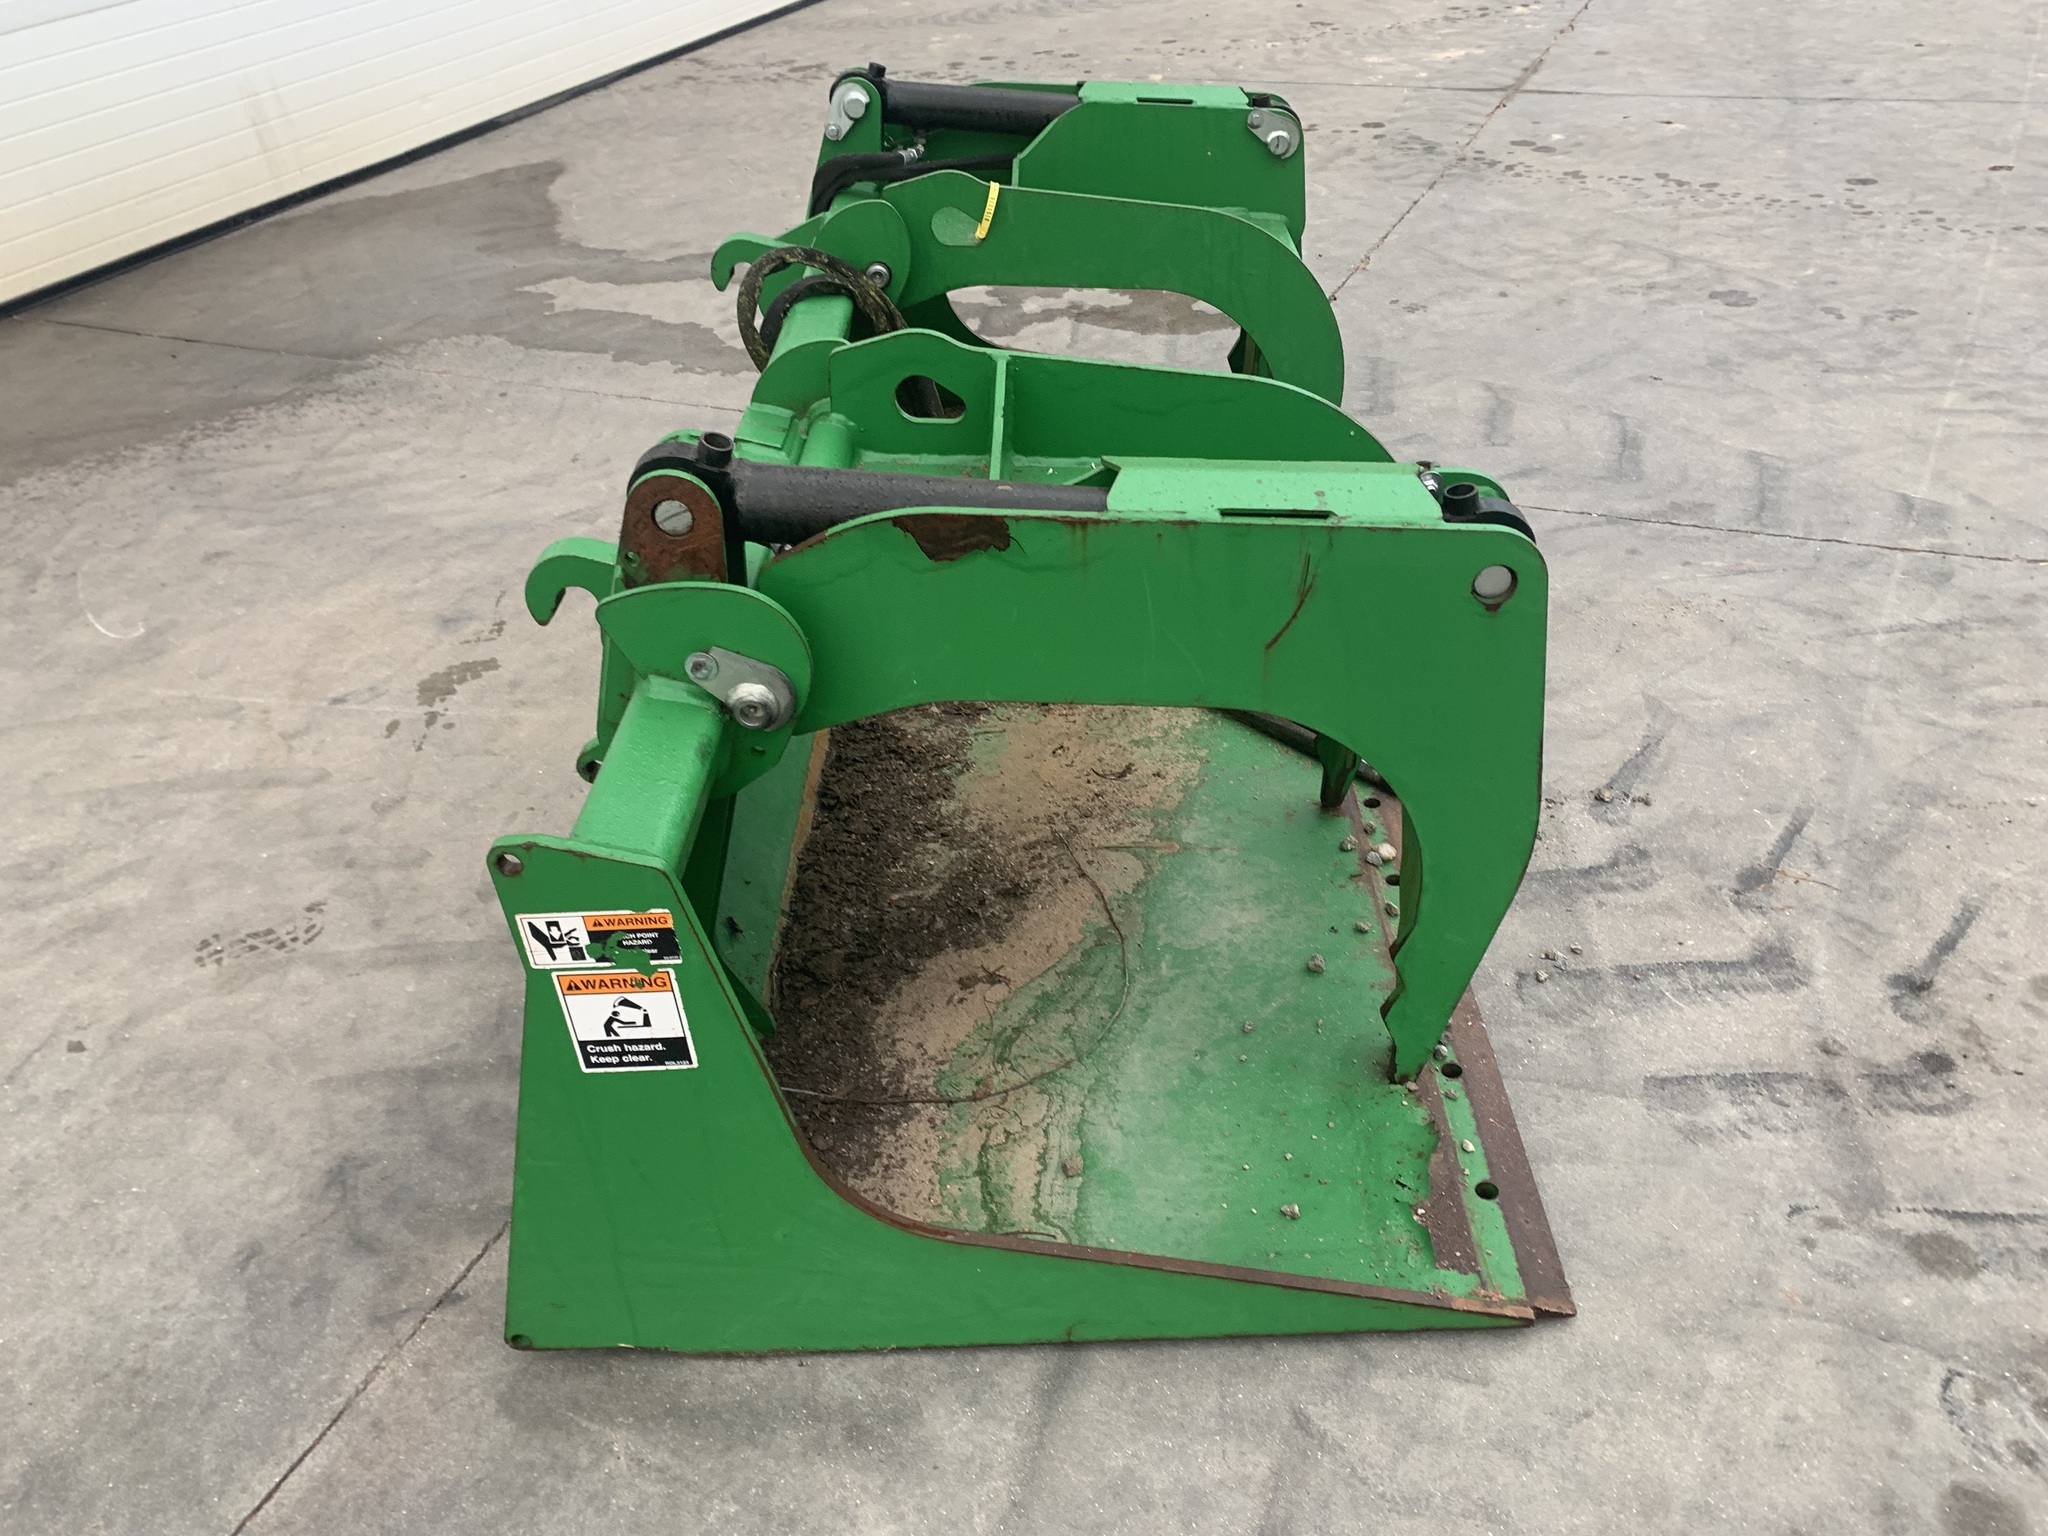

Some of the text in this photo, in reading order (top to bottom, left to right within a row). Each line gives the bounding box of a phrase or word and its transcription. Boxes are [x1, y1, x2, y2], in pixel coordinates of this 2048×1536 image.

[604, 916, 668, 927] WARNING
[586, 1042, 667, 1053] Crush hazard.
[590, 1054, 653, 1065] Keep clear.
